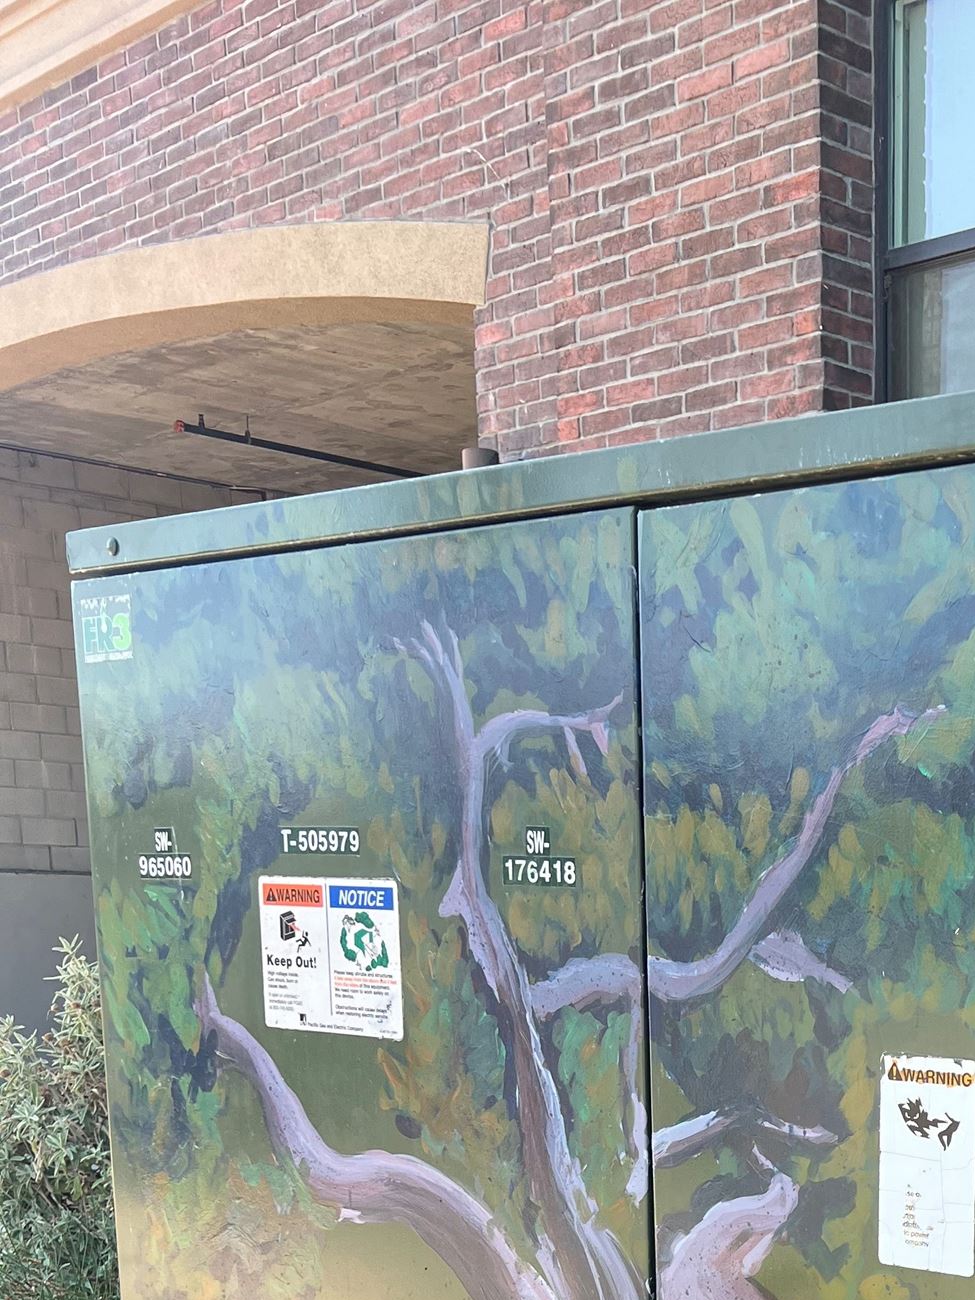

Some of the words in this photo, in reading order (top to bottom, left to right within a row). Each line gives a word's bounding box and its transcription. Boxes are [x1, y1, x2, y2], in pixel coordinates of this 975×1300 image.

[154, 831, 172, 851] SW-
[280, 829, 360, 853] T-505979
[526, 829, 550, 854] SW-
[138, 855, 191, 877] 965060
[504, 858, 576, 885] 176418
[276, 888, 320, 904] WARNING
[338, 889, 385, 907] NOTICE
[266, 954, 292, 969] Keep
[295, 956, 317, 969] Out!
[902, 1068, 973, 1088] WARNING
